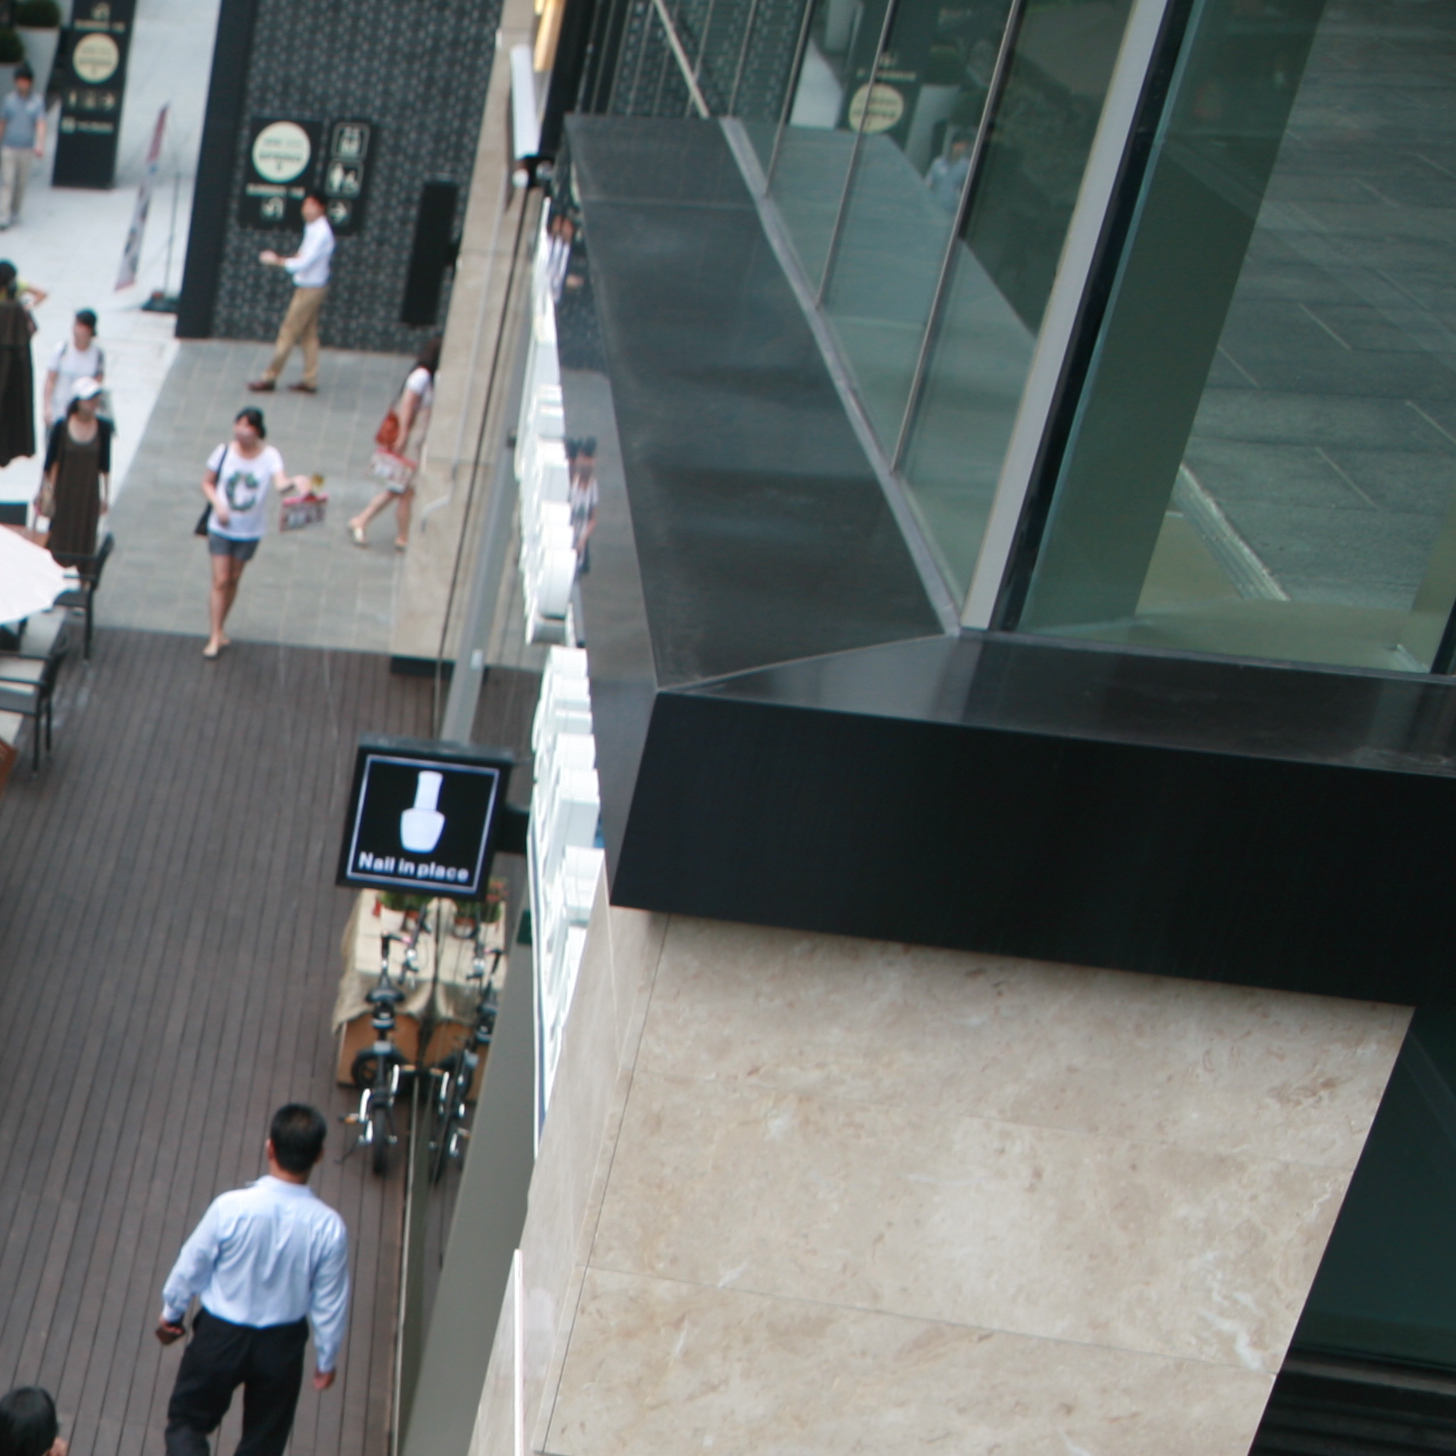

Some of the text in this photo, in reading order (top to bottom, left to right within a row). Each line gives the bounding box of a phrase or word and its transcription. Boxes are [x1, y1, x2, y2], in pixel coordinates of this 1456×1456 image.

[358, 851, 469, 883] Nail in place
